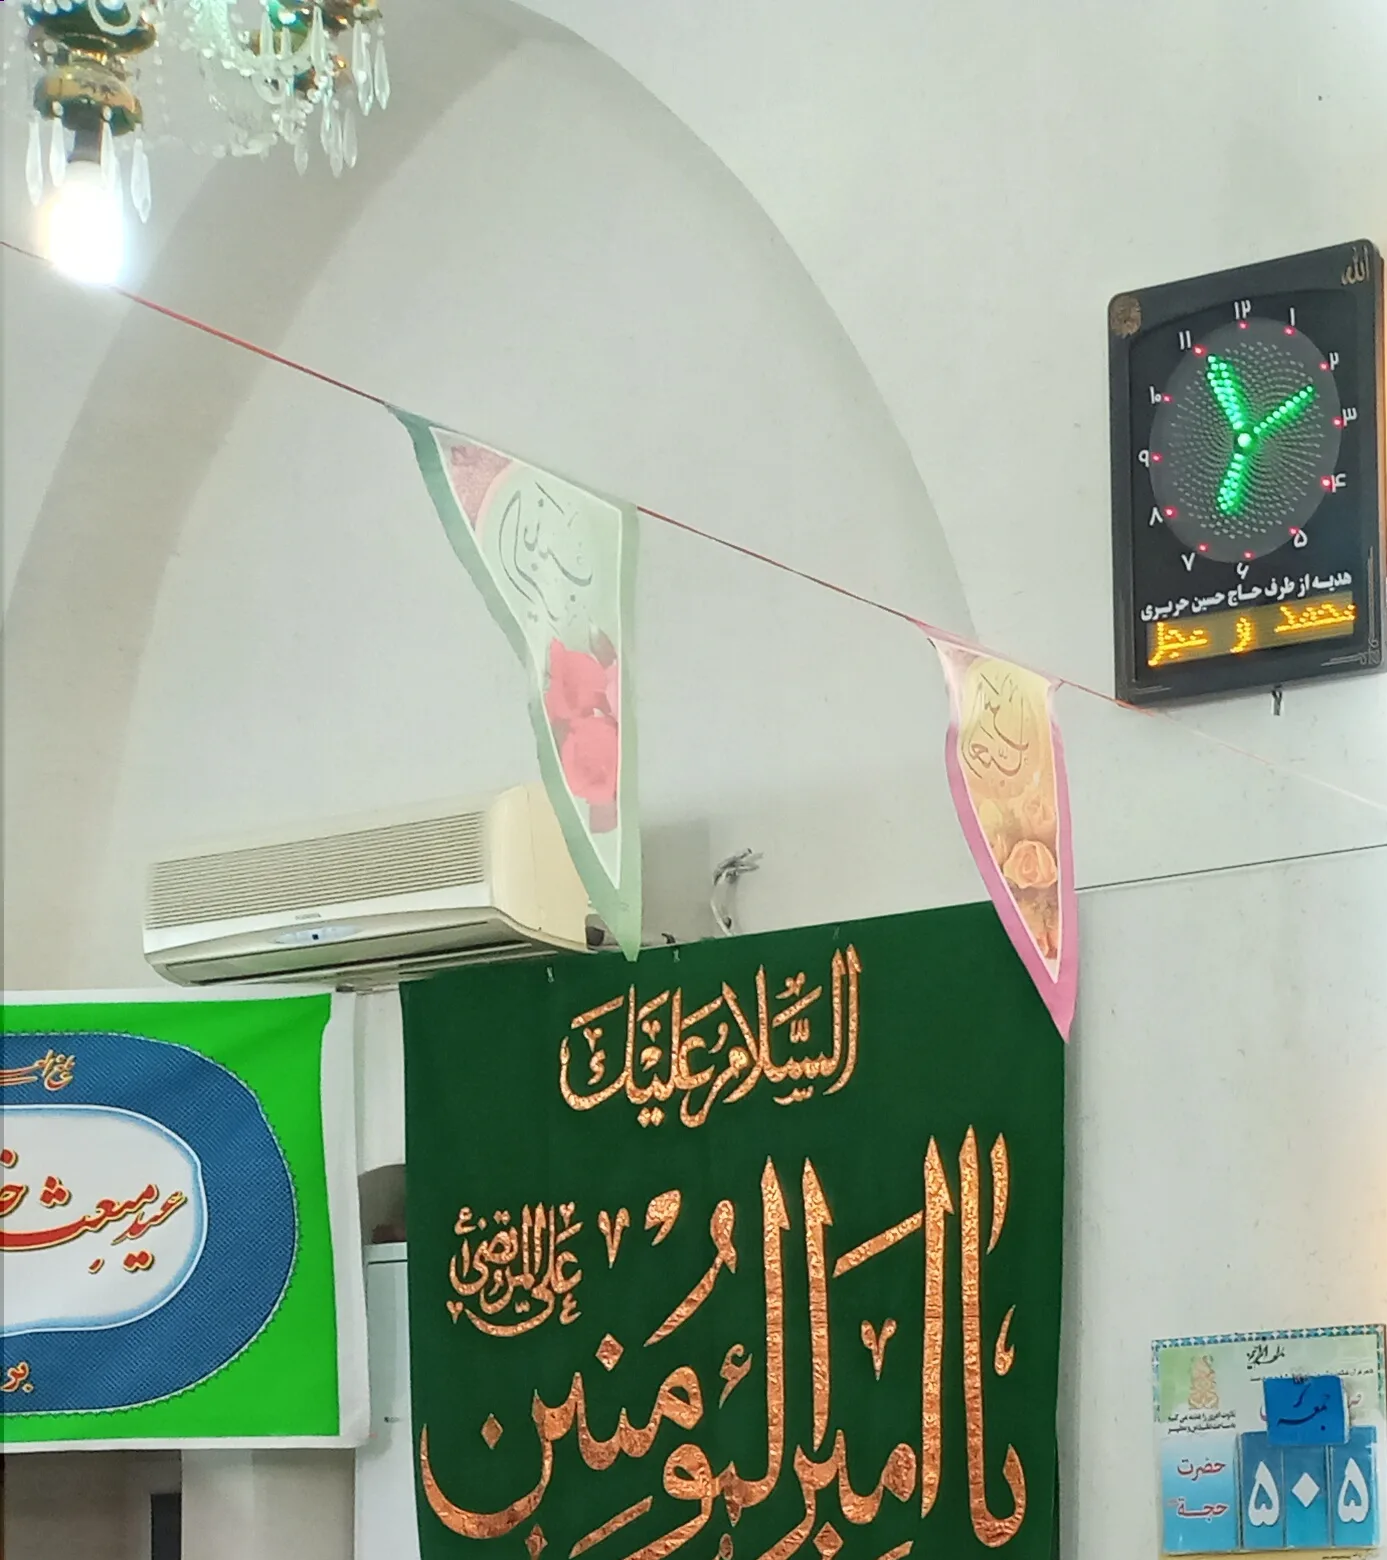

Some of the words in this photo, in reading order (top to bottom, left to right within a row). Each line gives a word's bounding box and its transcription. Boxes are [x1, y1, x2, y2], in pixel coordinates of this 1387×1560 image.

[1341, 246, 1371, 286] الله
[1234, 301, 1252, 319] ۱۲
[1289, 307, 1296, 326] ۱
[1178, 330, 1192, 350] ۱۱
[1328, 351, 1340, 370] ۲
[1149, 386, 1162, 405] ۱۰
[1341, 407, 1358, 425] ۳
[1138, 449, 1150, 466] ۹
[1330, 474, 1347, 493] ۴
[1148, 507, 1164, 526] ۸
[1293, 529, 1308, 548] ۵
[1181, 553, 1196, 572] ۷
[1237, 563, 1250, 579] ۶
[1264, 577, 1295, 600] طرف
[1298, 573, 1311, 598] از
[1141, 601, 1190, 621] حریری
[1192, 592, 1225, 613] حسین
[680, 944, 863, 1128] السلام
[560, 984, 715, 1128] علیک
[111, 1191, 188, 1273] عید
[1176, 1457, 1227, 1482] حضرت
[1176, 1500, 1229, 1523] حجة
